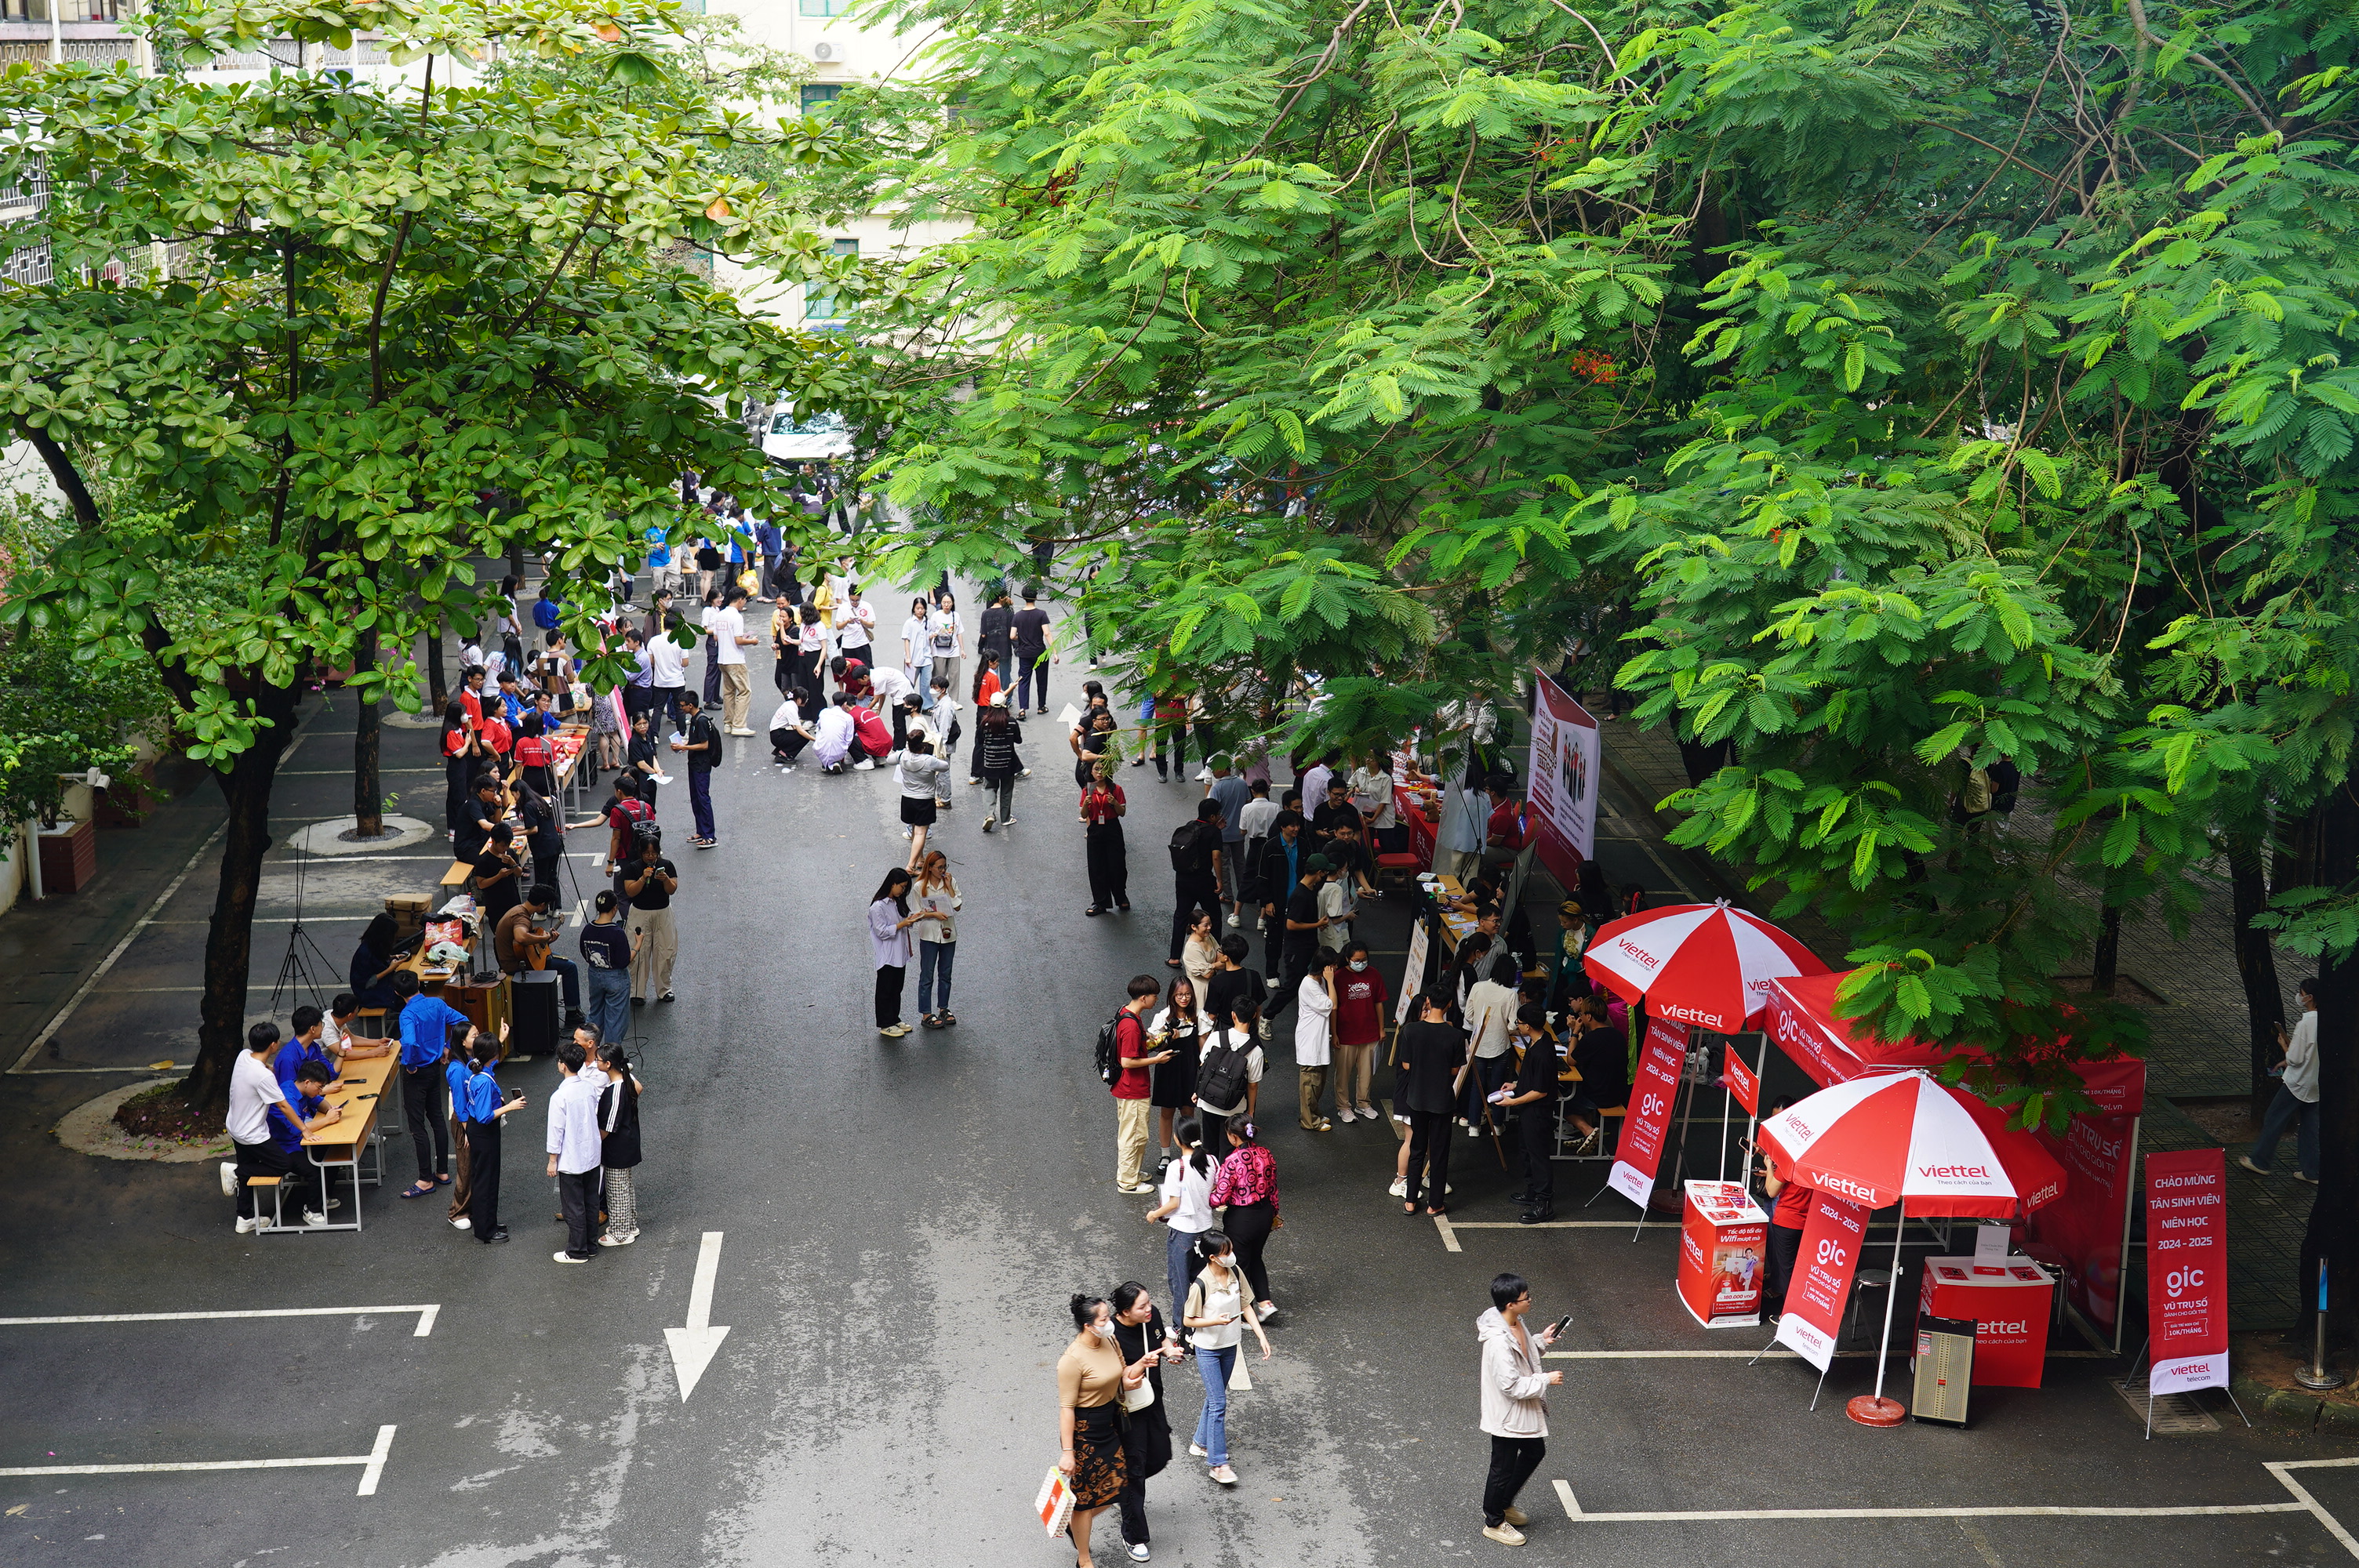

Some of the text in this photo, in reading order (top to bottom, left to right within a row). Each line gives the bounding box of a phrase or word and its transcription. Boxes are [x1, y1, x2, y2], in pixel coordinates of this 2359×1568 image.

[1618, 938, 1660, 969] viettel
[1659, 1004, 1724, 1028] viettel
[1778, 1010, 1798, 1042] gic
[1651, 1025, 1686, 1053] TÂN SINH VIÊN
[1652, 1047, 1665, 1061] NIÊN
[1664, 1055, 1676, 1066] HỌC
[1645, 1062, 1659, 1076] 2024
[1660, 1071, 1675, 1085] 2025
[1731, 1061, 1750, 1092] viettel
[1641, 1093, 1664, 1116] gic
[1636, 1116, 1661, 1135] VŨ TRỤ SỐ
[1786, 1113, 1815, 1142] viettel
[2081, 1122, 2102, 1152] TRỤ
[1623, 1170, 1644, 1189] viettel
[1918, 1164, 1990, 1178] viettel
[2155, 1173, 2215, 1189] CHÀO MỪNG
[1812, 1171, 1877, 1203] viettel
[2026, 1181, 2059, 1208] viettel
[2150, 1192, 2220, 1209] TÂN SINH VIÊN
[1819, 1203, 1839, 1221] 2024
[1842, 1216, 1860, 1233] 2025
[2161, 1216, 2208, 1229] NIÊN HỌC
[1817, 1237, 1846, 1267] gic
[2157, 1239, 2182, 1250] 2024
[2188, 1236, 2212, 1247] 2025
[1811, 1264, 1842, 1288] VŨ TRỤ SỐ
[2166, 1265, 2205, 1298] gic
[2163, 1296, 2208, 1310] VŨ TRỤ SỐ
[1795, 1325, 1822, 1349] viettel
[2168, 1327, 2202, 1336] 10K/THÁNG
[1802, 1342, 1819, 1356] telecom
[2171, 1363, 2211, 1376] viettel
